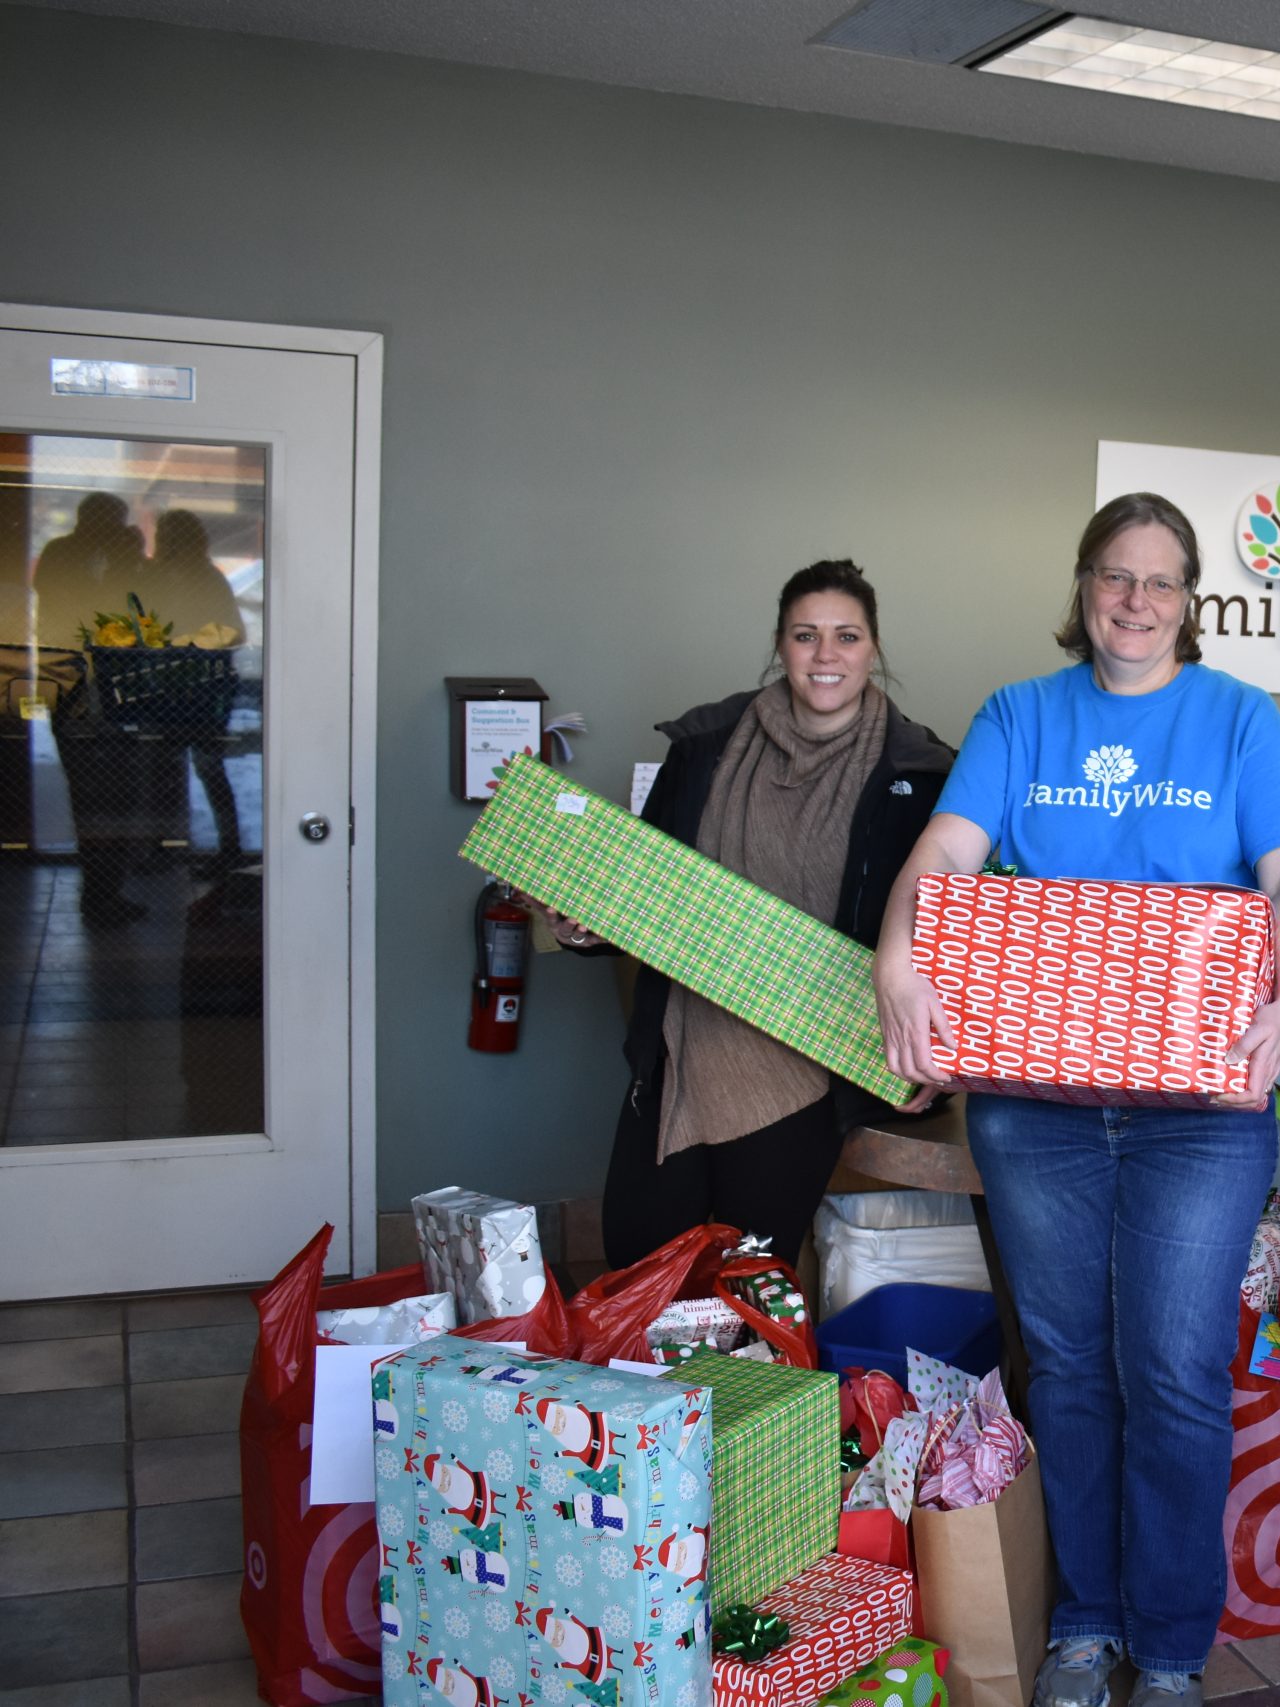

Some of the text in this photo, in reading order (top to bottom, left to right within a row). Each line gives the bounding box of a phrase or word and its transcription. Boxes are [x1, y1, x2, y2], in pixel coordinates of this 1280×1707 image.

[683, 1302, 722, 1313] himself
[527, 1419, 542, 1490] Merry
[648, 1571, 663, 1638] Merry
[527, 1630, 543, 1698] Merry
